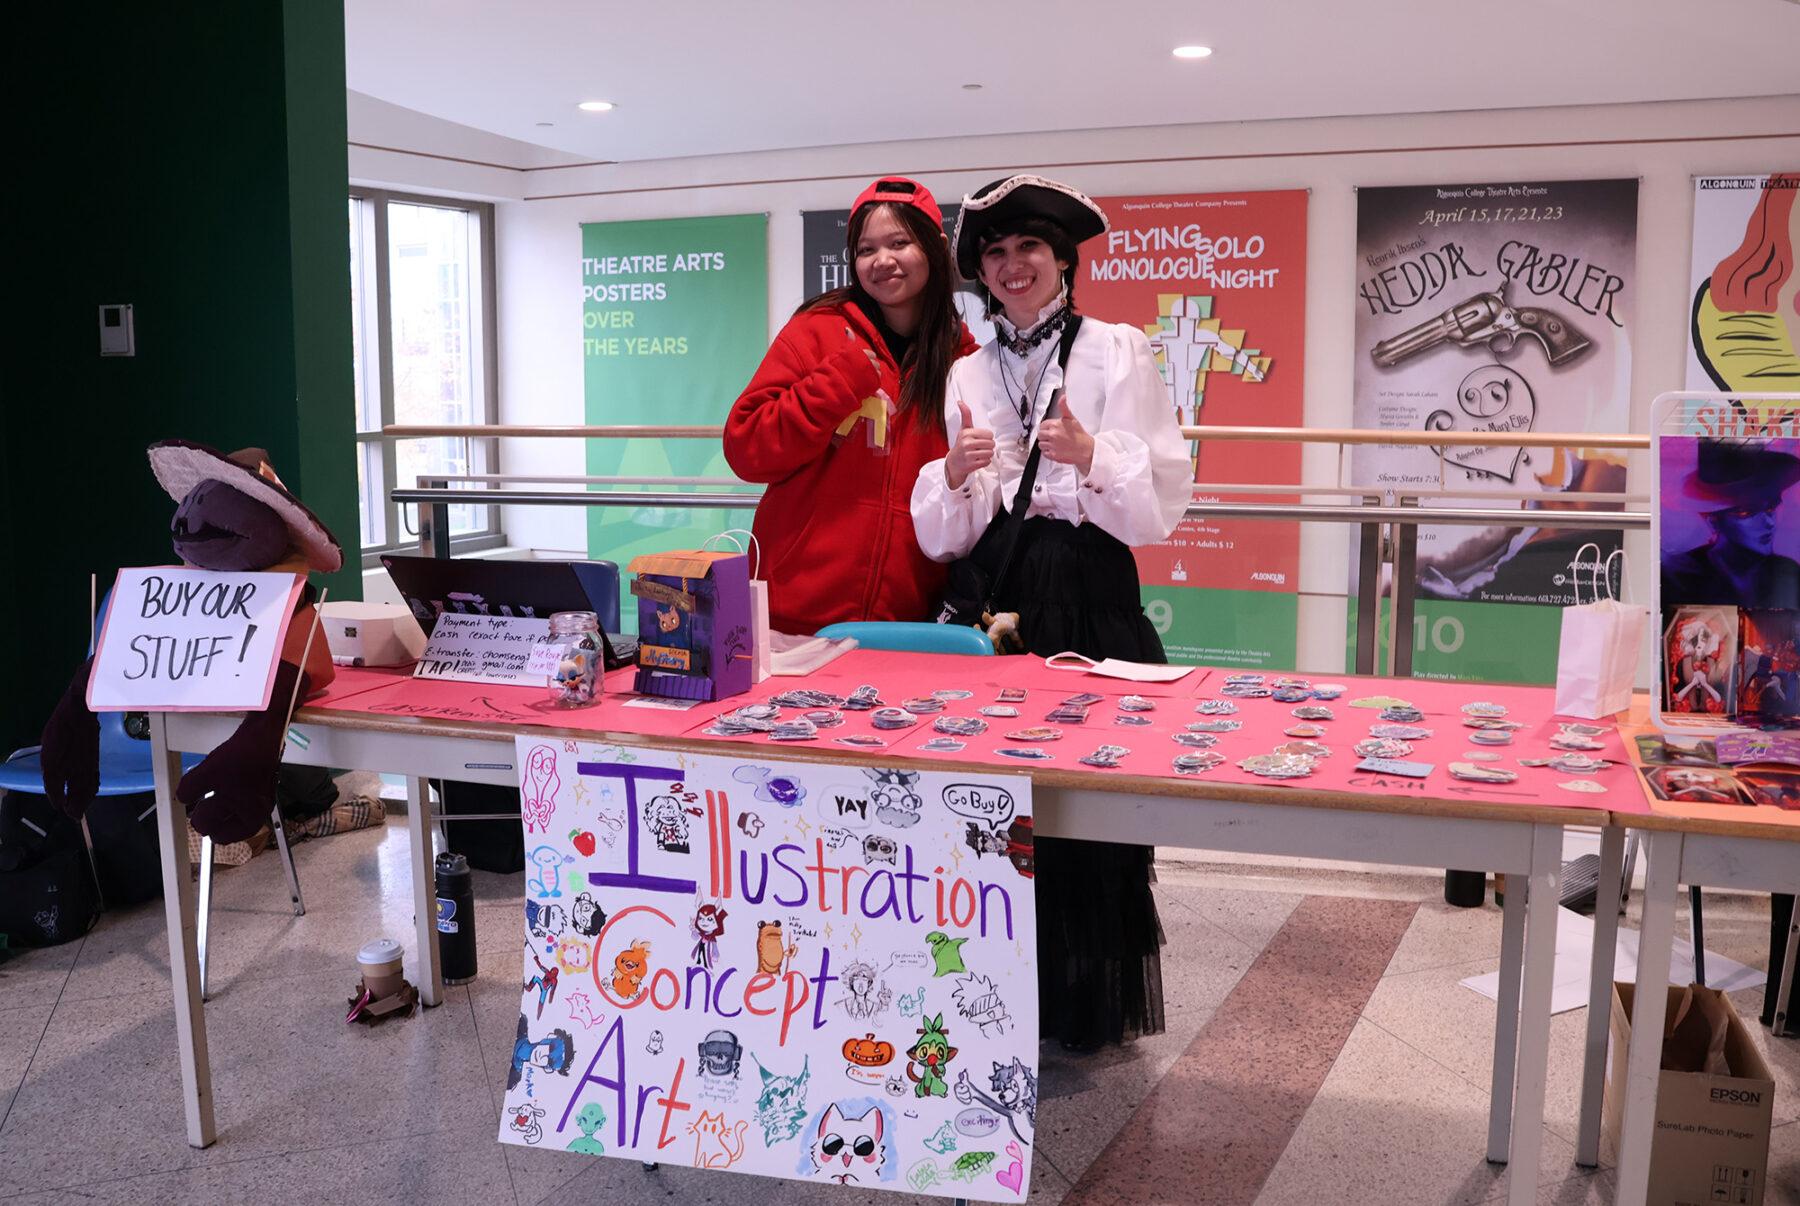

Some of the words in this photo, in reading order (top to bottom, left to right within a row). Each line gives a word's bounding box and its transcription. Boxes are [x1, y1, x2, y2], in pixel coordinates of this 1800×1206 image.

[1701, 179, 1755, 189] ALGONQUIN
[1419, 207, 1467, 227] April
[1108, 224, 1201, 254] FLYING
[1195, 236, 1264, 259] SOLO
[582, 254, 668, 276] THEATRE
[672, 252, 725, 272] ARTS
[820, 254, 838, 264] THE
[1091, 253, 1214, 281] MONOLOGUE
[1210, 269, 1279, 289] NIGHT
[1360, 242, 1487, 315] HEDDA
[1497, 240, 1624, 327] GABLER
[583, 282, 667, 302] POSTERS
[584, 311, 634, 329] OVER
[584, 338, 619, 355] THE
[624, 337, 688, 355] YEARS
[1196, 540, 1218, 548] Adults
[140, 576, 205, 619] BUY
[200, 582, 257, 619] OUR
[443, 615, 482, 629] Payment
[835, 795, 868, 820] YAY
[949, 790, 967, 806] Go
[577, 762, 1013, 940] Illustration
[593, 905, 839, 1047] Concept
[555, 1015, 692, 1150] Art
[1710, 1087, 1761, 1104] EPSON
[1657, 1120, 1695, 1134] SureLab
[1698, 1125, 1725, 1137] Photo
[1727, 1129, 1755, 1140] Paper
